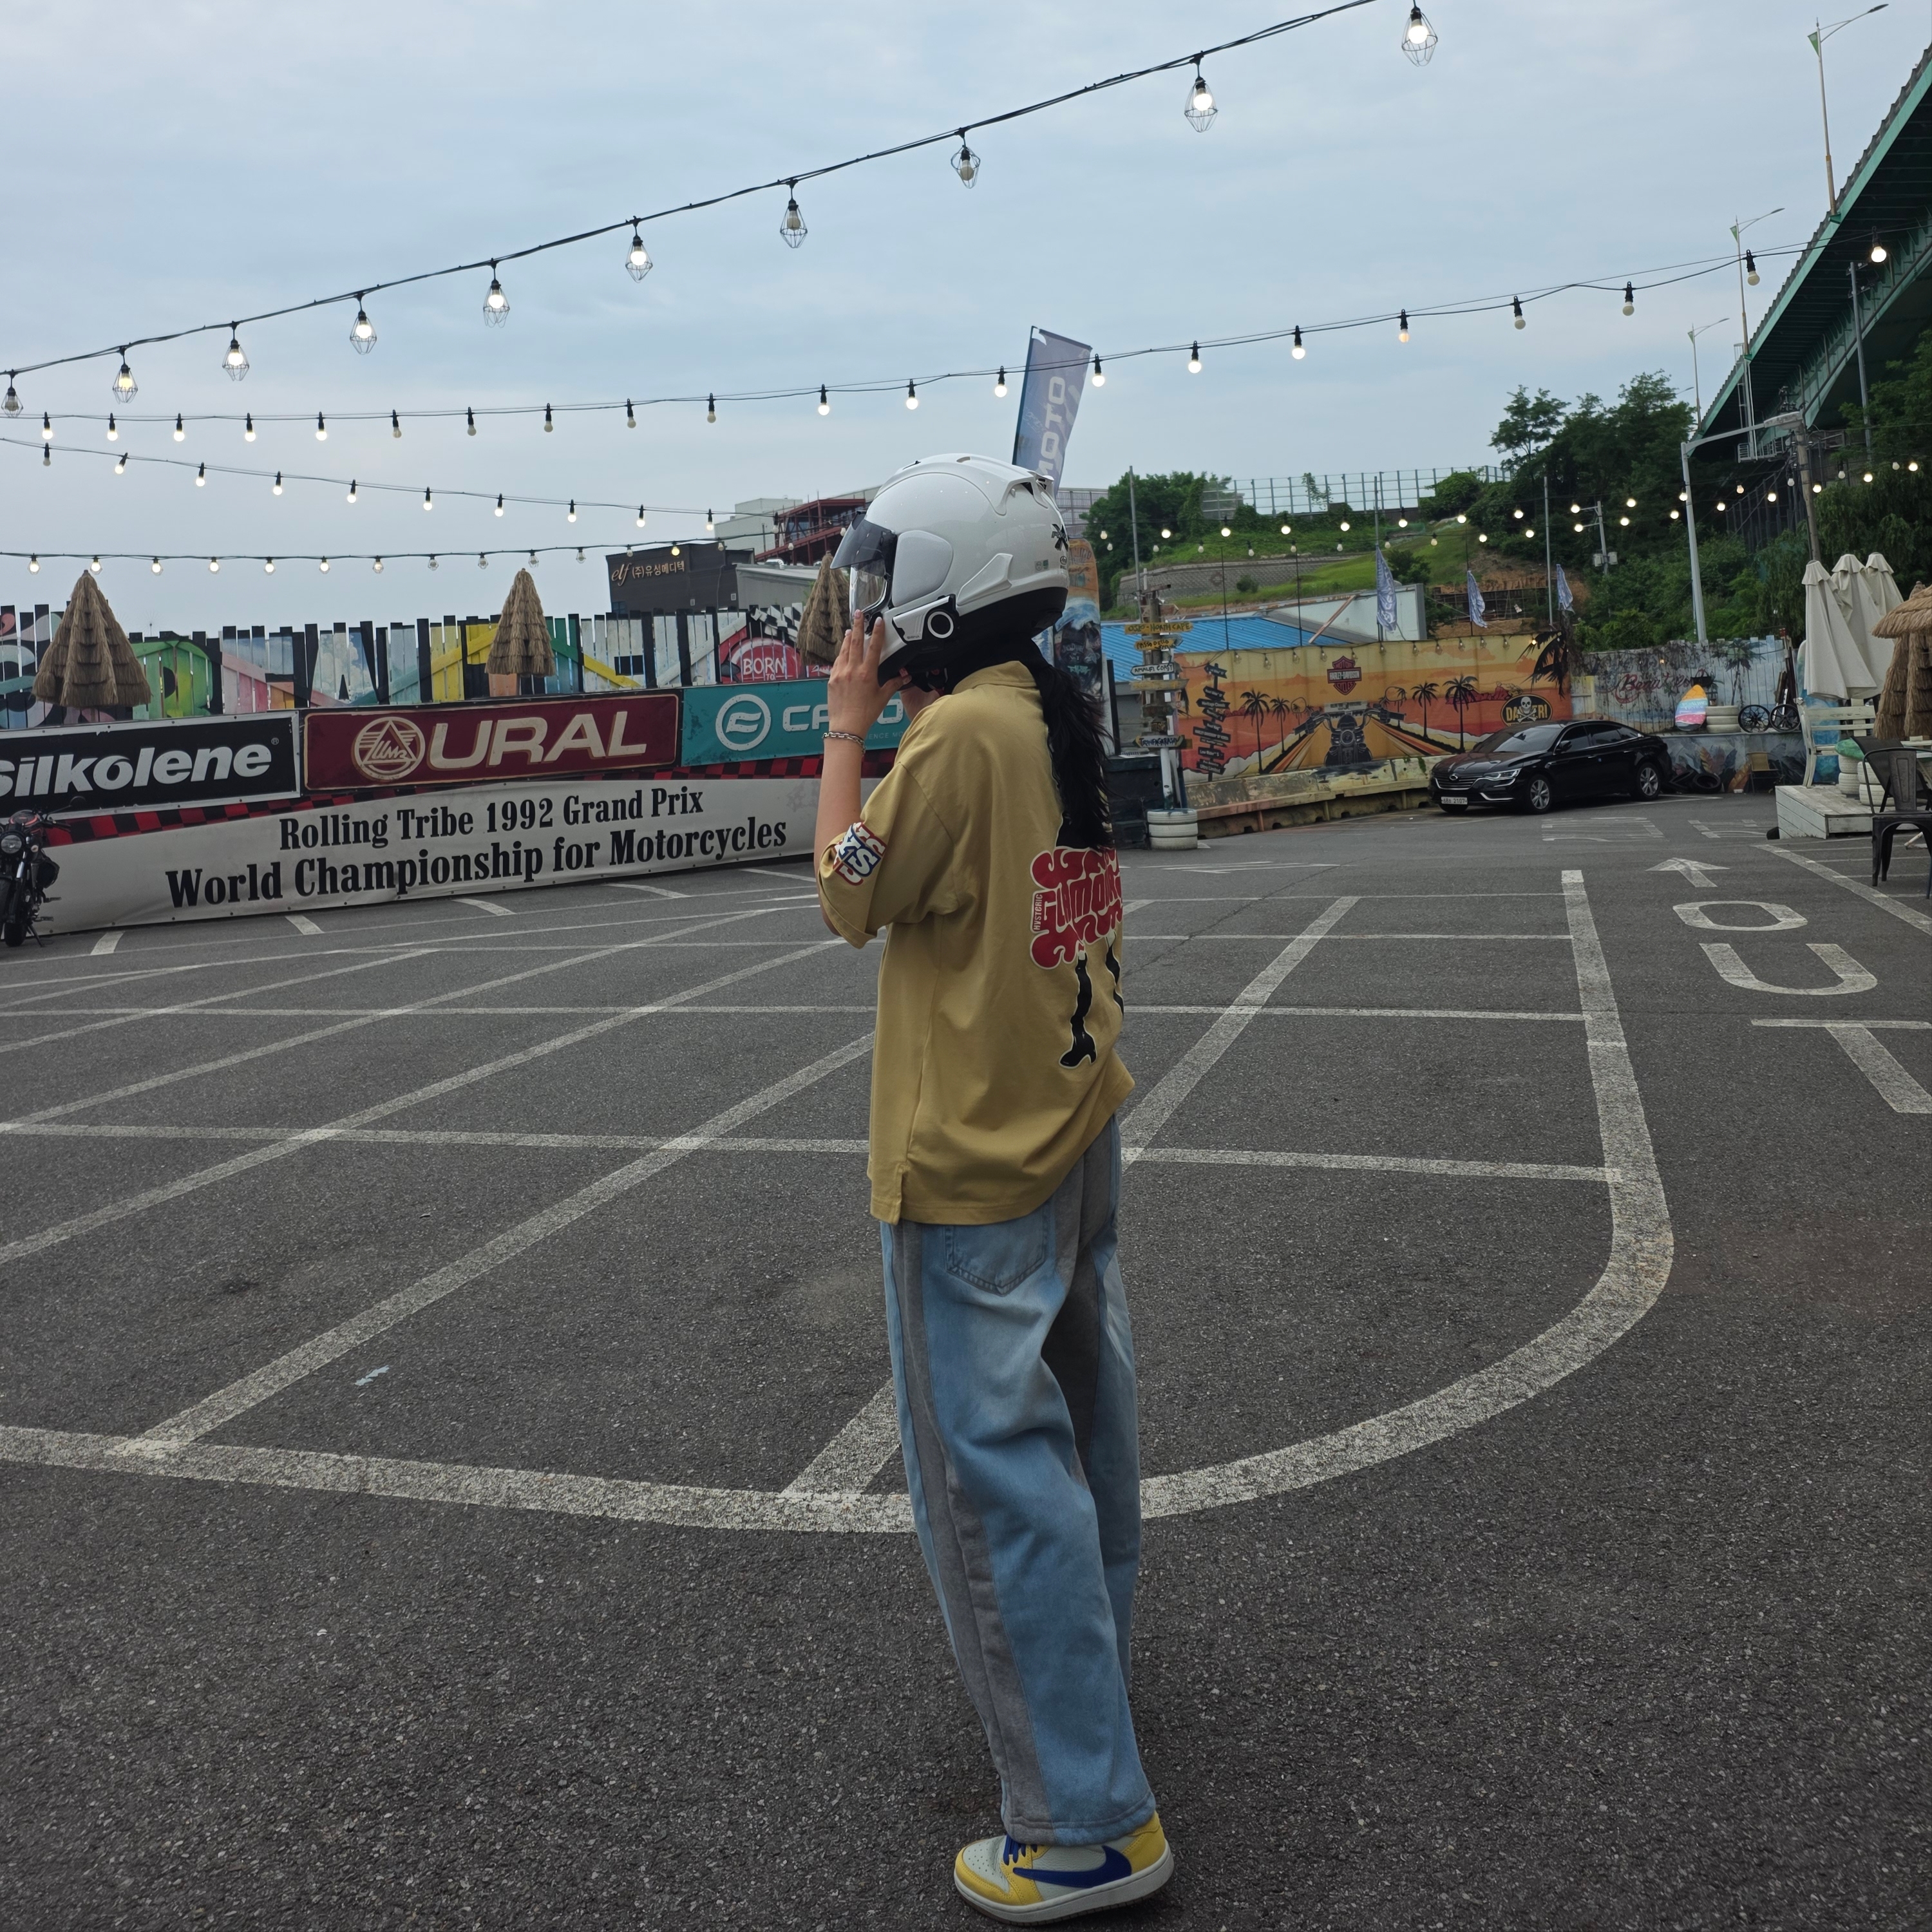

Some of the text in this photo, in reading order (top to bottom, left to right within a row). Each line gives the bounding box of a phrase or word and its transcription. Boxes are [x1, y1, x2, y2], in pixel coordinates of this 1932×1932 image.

[1172, 622, 1190, 631] CAPE
[743, 657, 785, 676] BORN
[430, 710, 647, 770] URAL
[279, 785, 703, 851] Rolling Tribe 1992 Grand Prix
[166, 815, 787, 908] World Championship for Motorcycles
